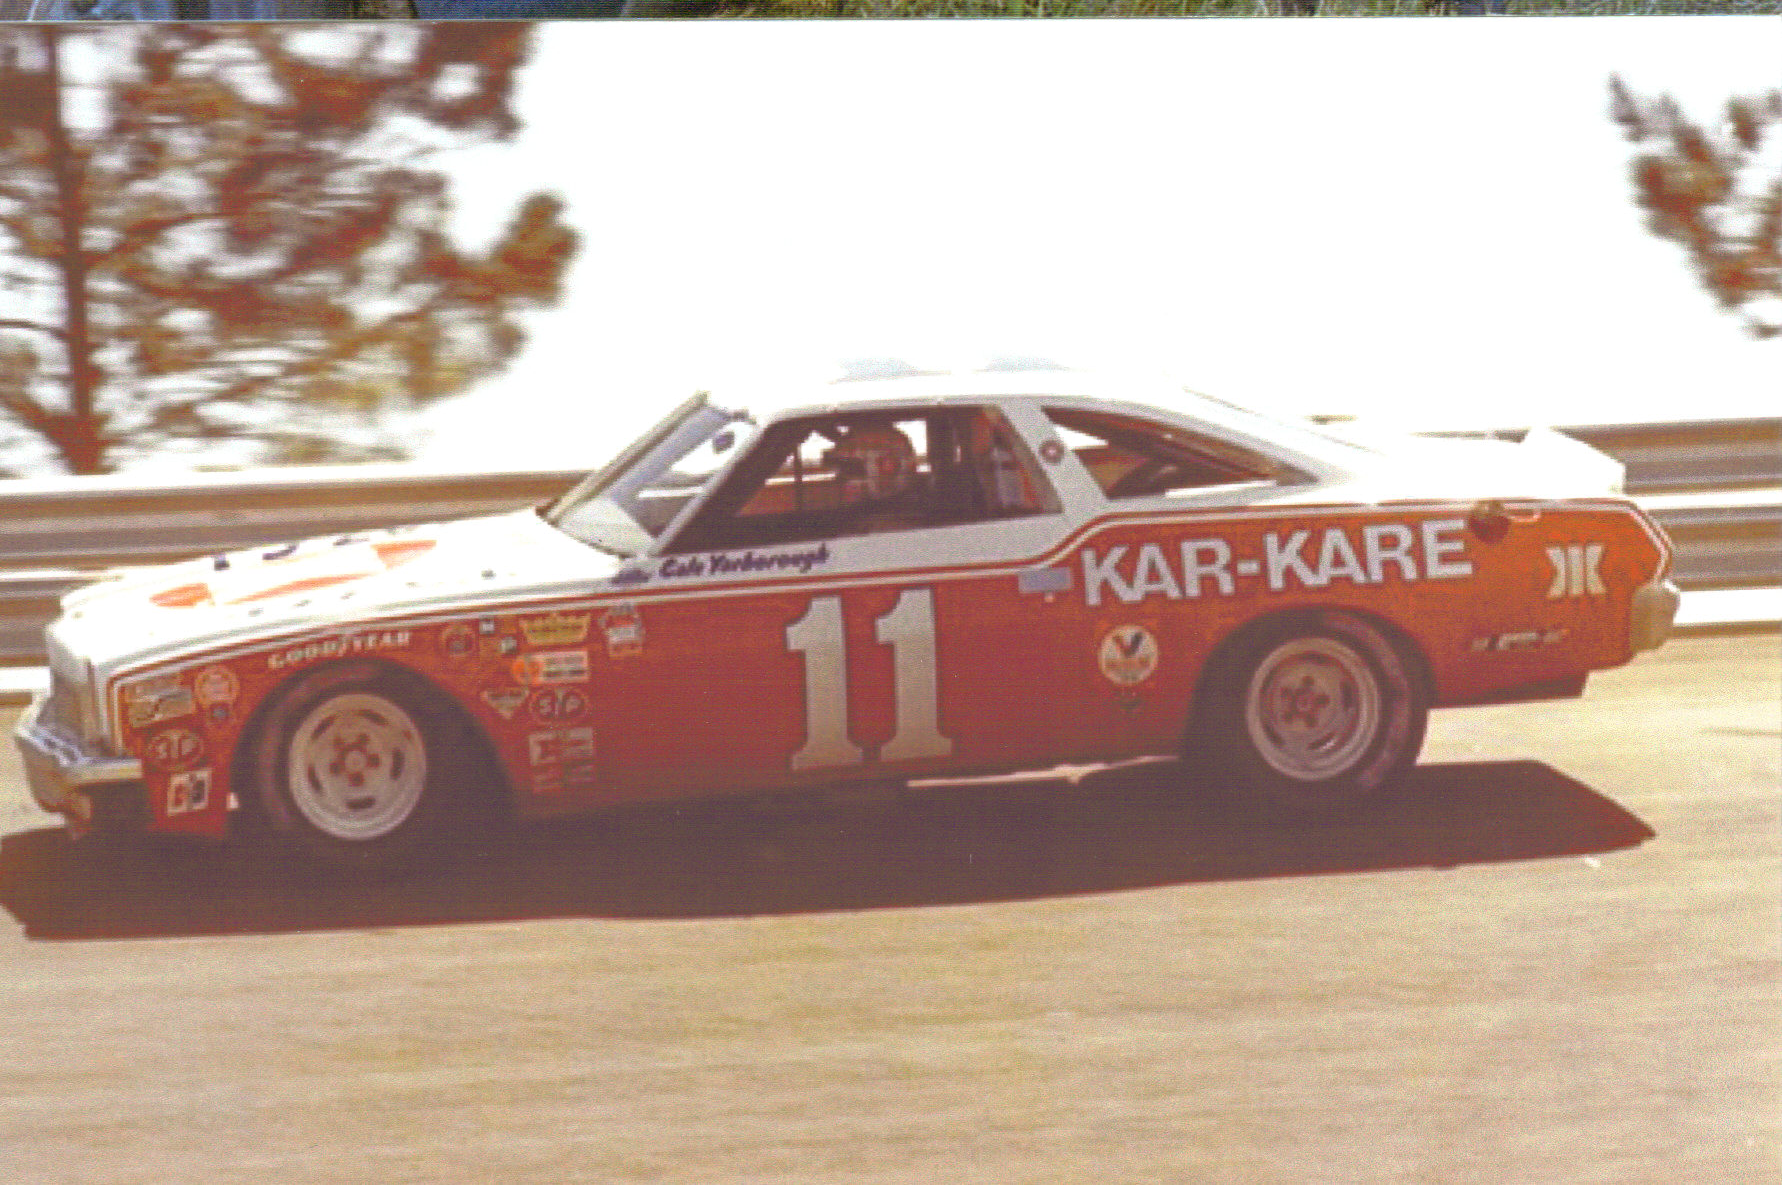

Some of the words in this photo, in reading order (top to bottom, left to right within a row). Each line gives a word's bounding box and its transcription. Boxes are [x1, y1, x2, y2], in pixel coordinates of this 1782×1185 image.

[659, 556, 704, 577] Cale
[710, 542, 830, 574] Yarborough
[1081, 519, 1473, 607] KAR-KARE
[785, 587, 953, 770] 11
